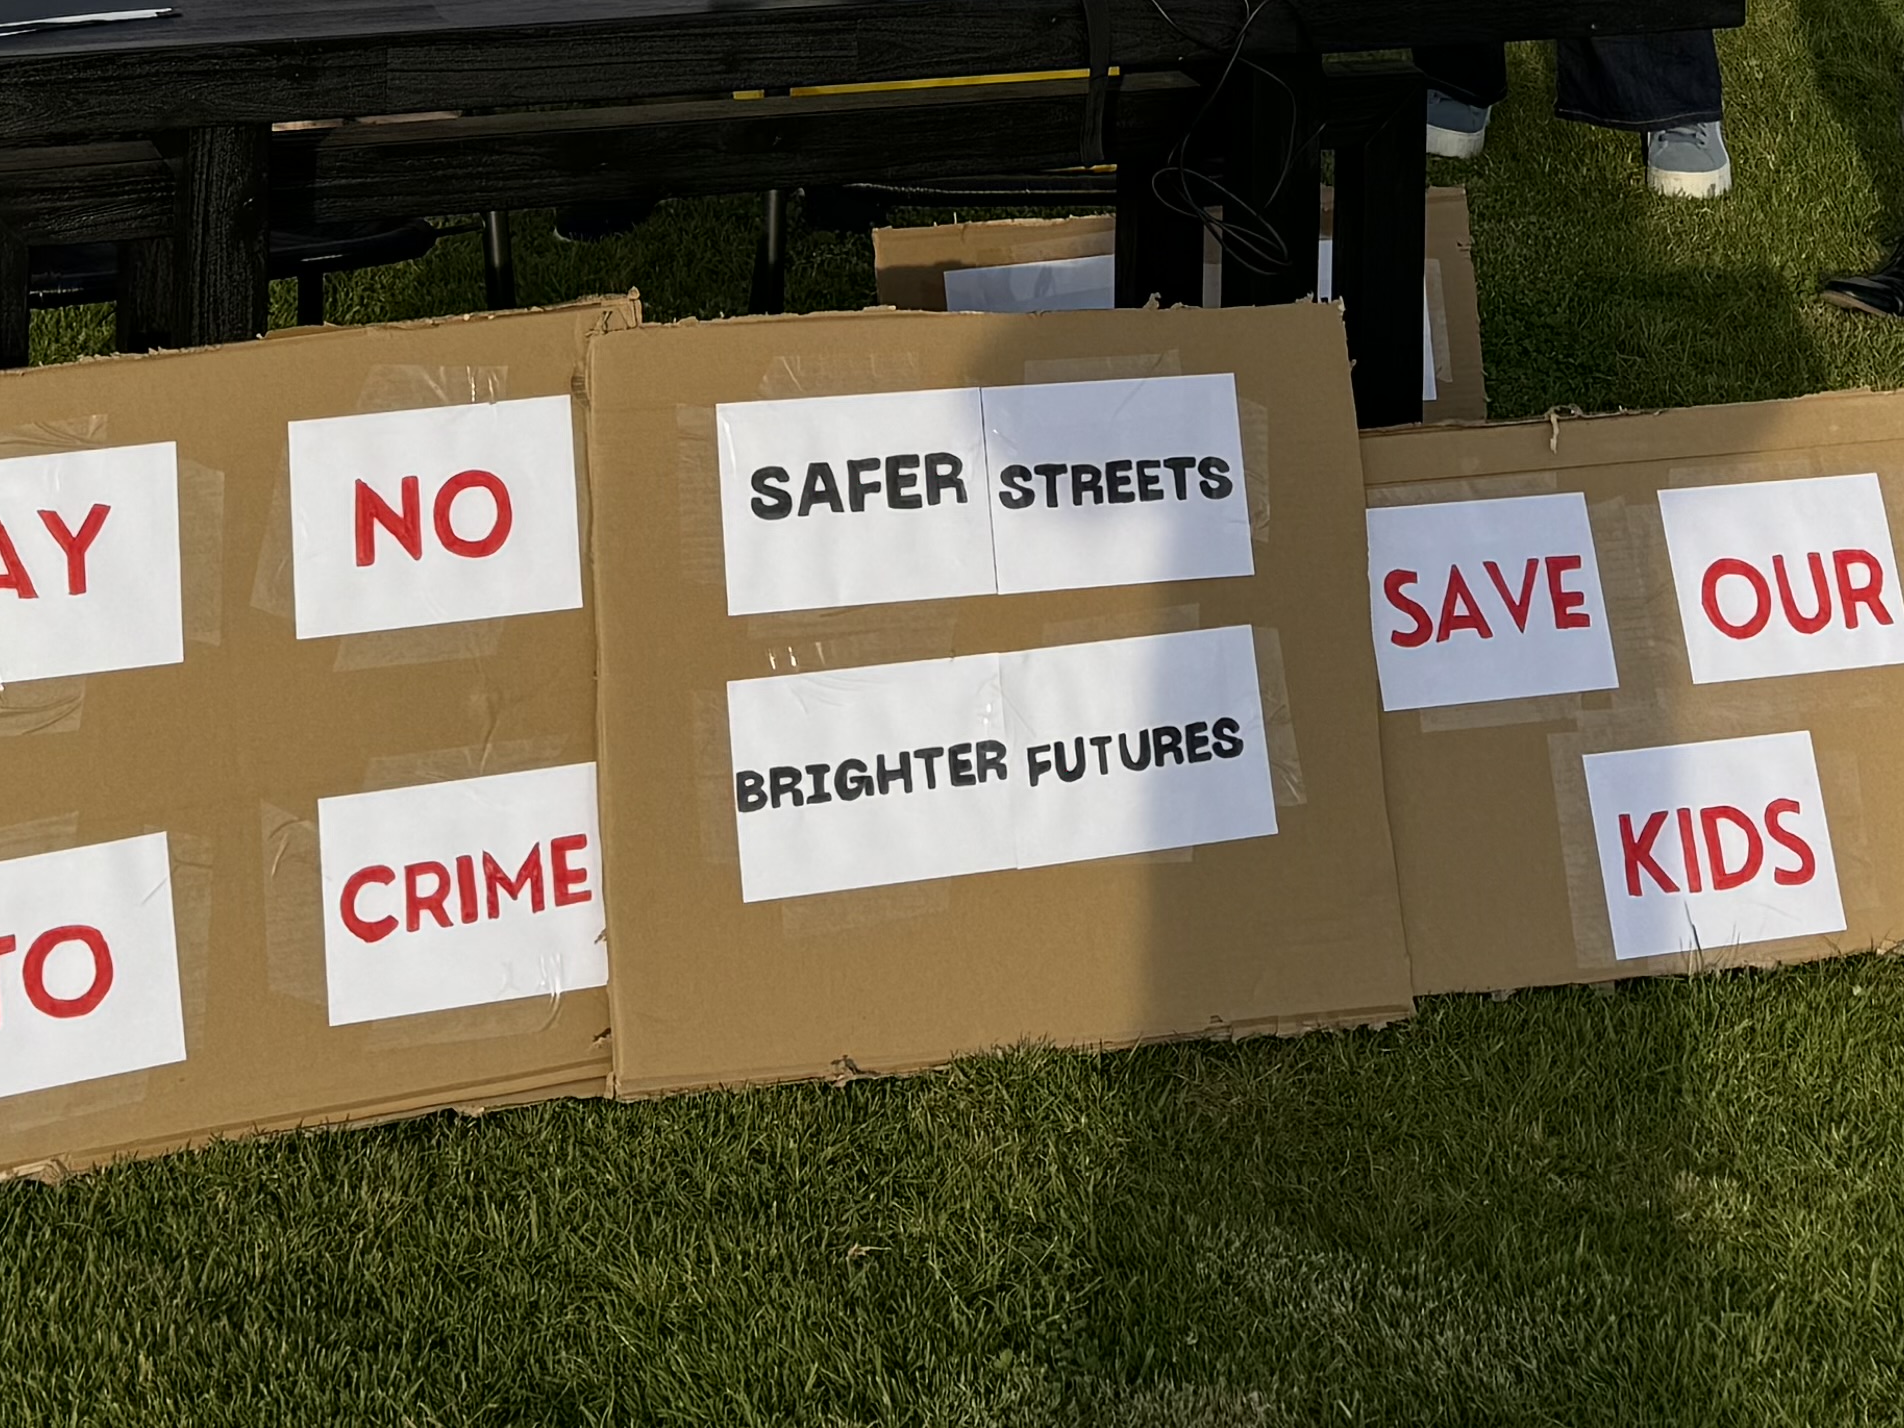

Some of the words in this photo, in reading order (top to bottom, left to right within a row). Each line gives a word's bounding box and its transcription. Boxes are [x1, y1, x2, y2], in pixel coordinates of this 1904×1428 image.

[354, 469, 515, 568] NO
[749, 452, 968, 521] SAFER
[998, 455, 1234, 511] STREETS
[1382, 554, 1592, 649] SAVE
[1700, 548, 1895, 641] OUR
[736, 739, 1008, 814] BRIGHTER
[1026, 716, 1245, 788] FUTURES
[339, 833, 593, 944] CRIME
[1617, 797, 1817, 898] KIDS
